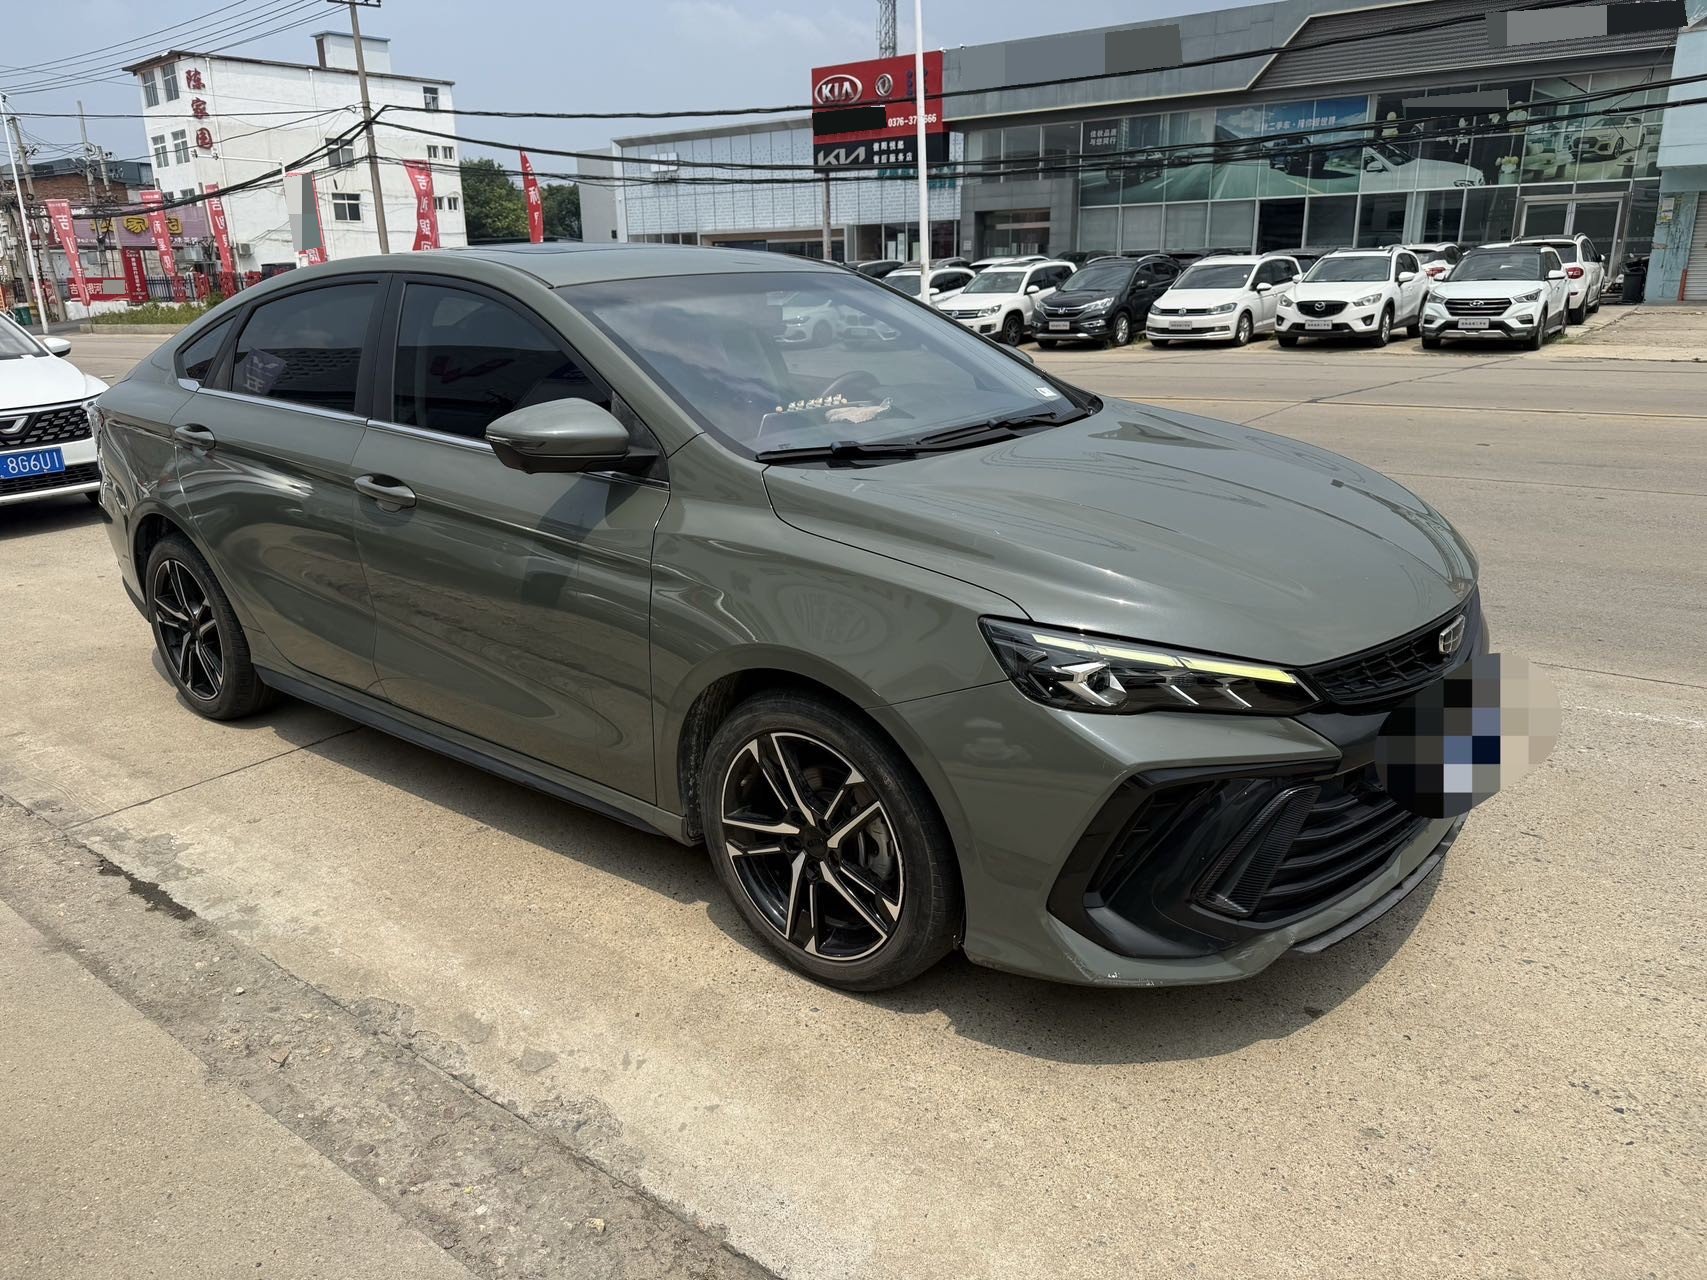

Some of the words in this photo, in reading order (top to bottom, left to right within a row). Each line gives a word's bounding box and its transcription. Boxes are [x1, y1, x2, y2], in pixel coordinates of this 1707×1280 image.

[821, 81, 855, 102] KIA
[69, 282, 103, 296] 吉银河
